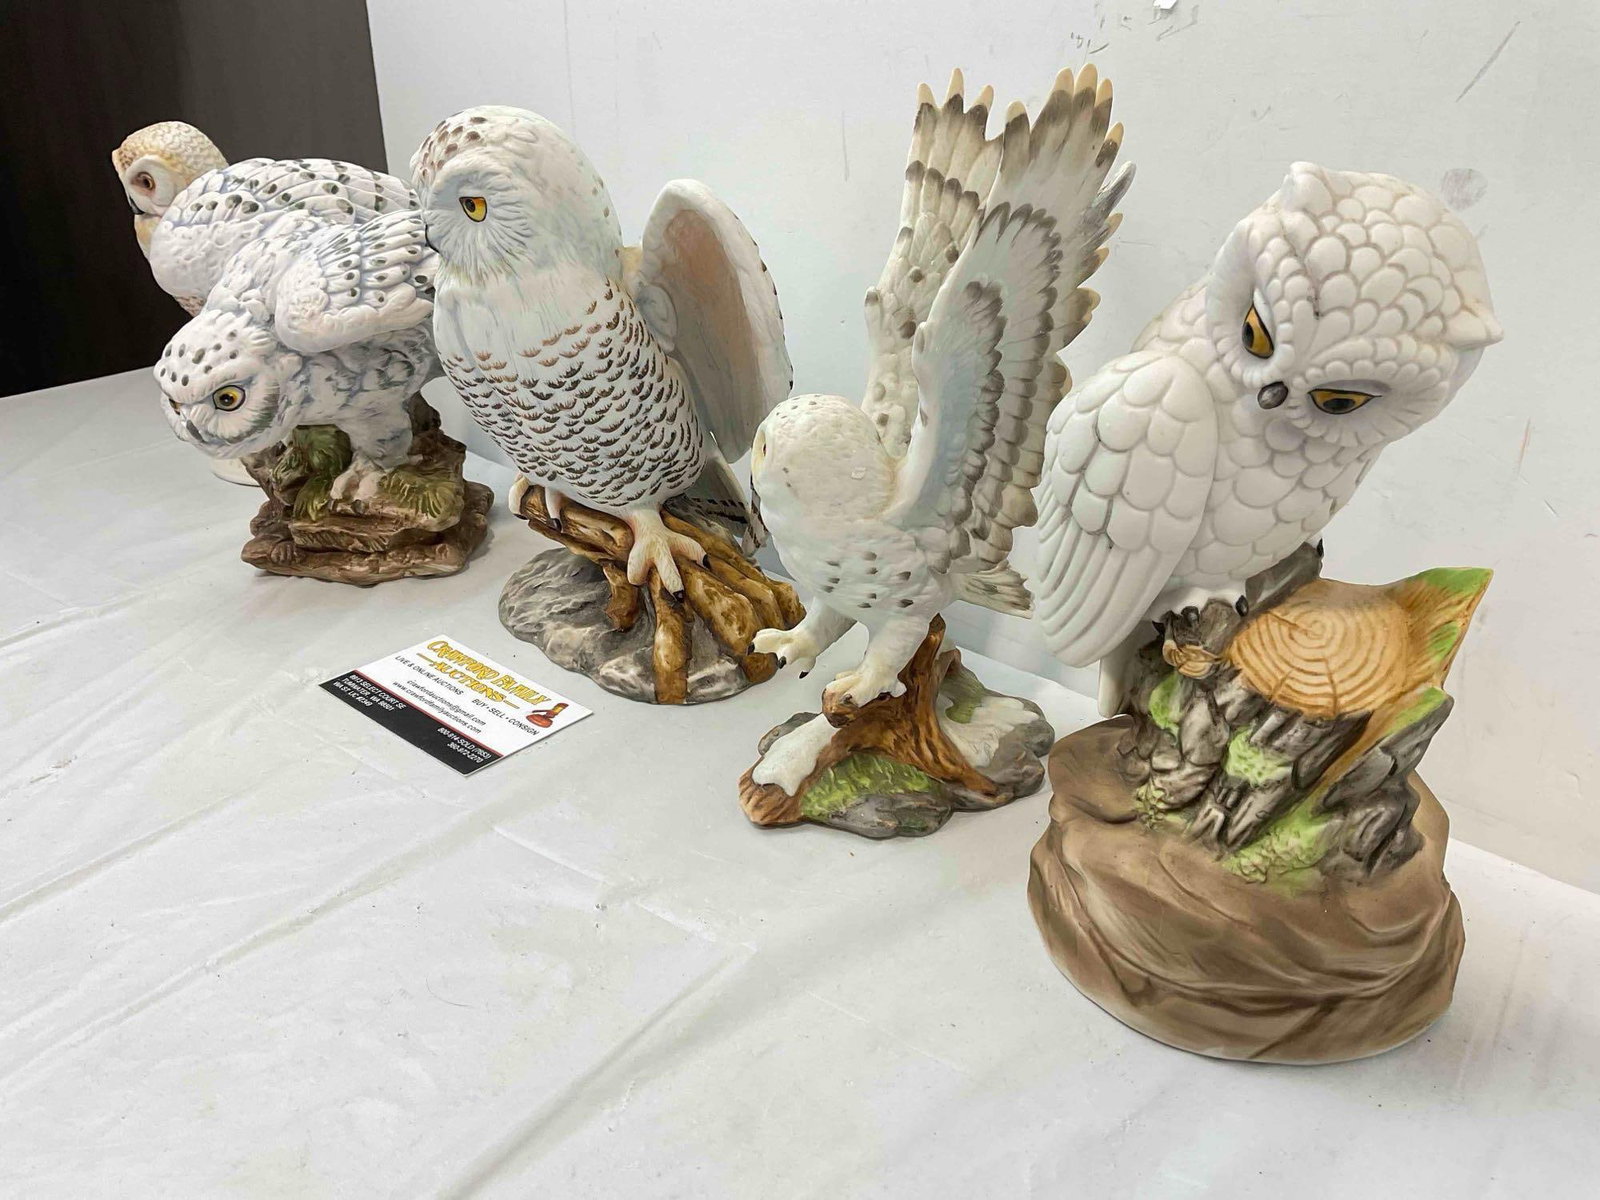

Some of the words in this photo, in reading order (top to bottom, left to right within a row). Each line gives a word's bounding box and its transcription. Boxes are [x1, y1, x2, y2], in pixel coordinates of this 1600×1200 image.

[333, 681, 344, 689] WA
[395, 655, 410, 665] LIVE
[413, 665, 436, 679] ONLINE
[432, 677, 464, 695] AUCTIONS
[429, 661, 506, 703] AUCTIONS
[491, 674, 552, 706] FAMILY
[360, 680, 382, 694] SELECT
[379, 692, 400, 705] COURT
[396, 702, 407, 710] SE
[369, 695, 381, 703] WA
[392, 681, 482, 735] www.crawfordfamilyauctions.com
[406, 679, 487, 727] crawfordauctions@gmail.com
[472, 698, 488, 708] BUY
[488, 707, 506, 719] SELL
[508, 718, 540, 736] CONSIGN
